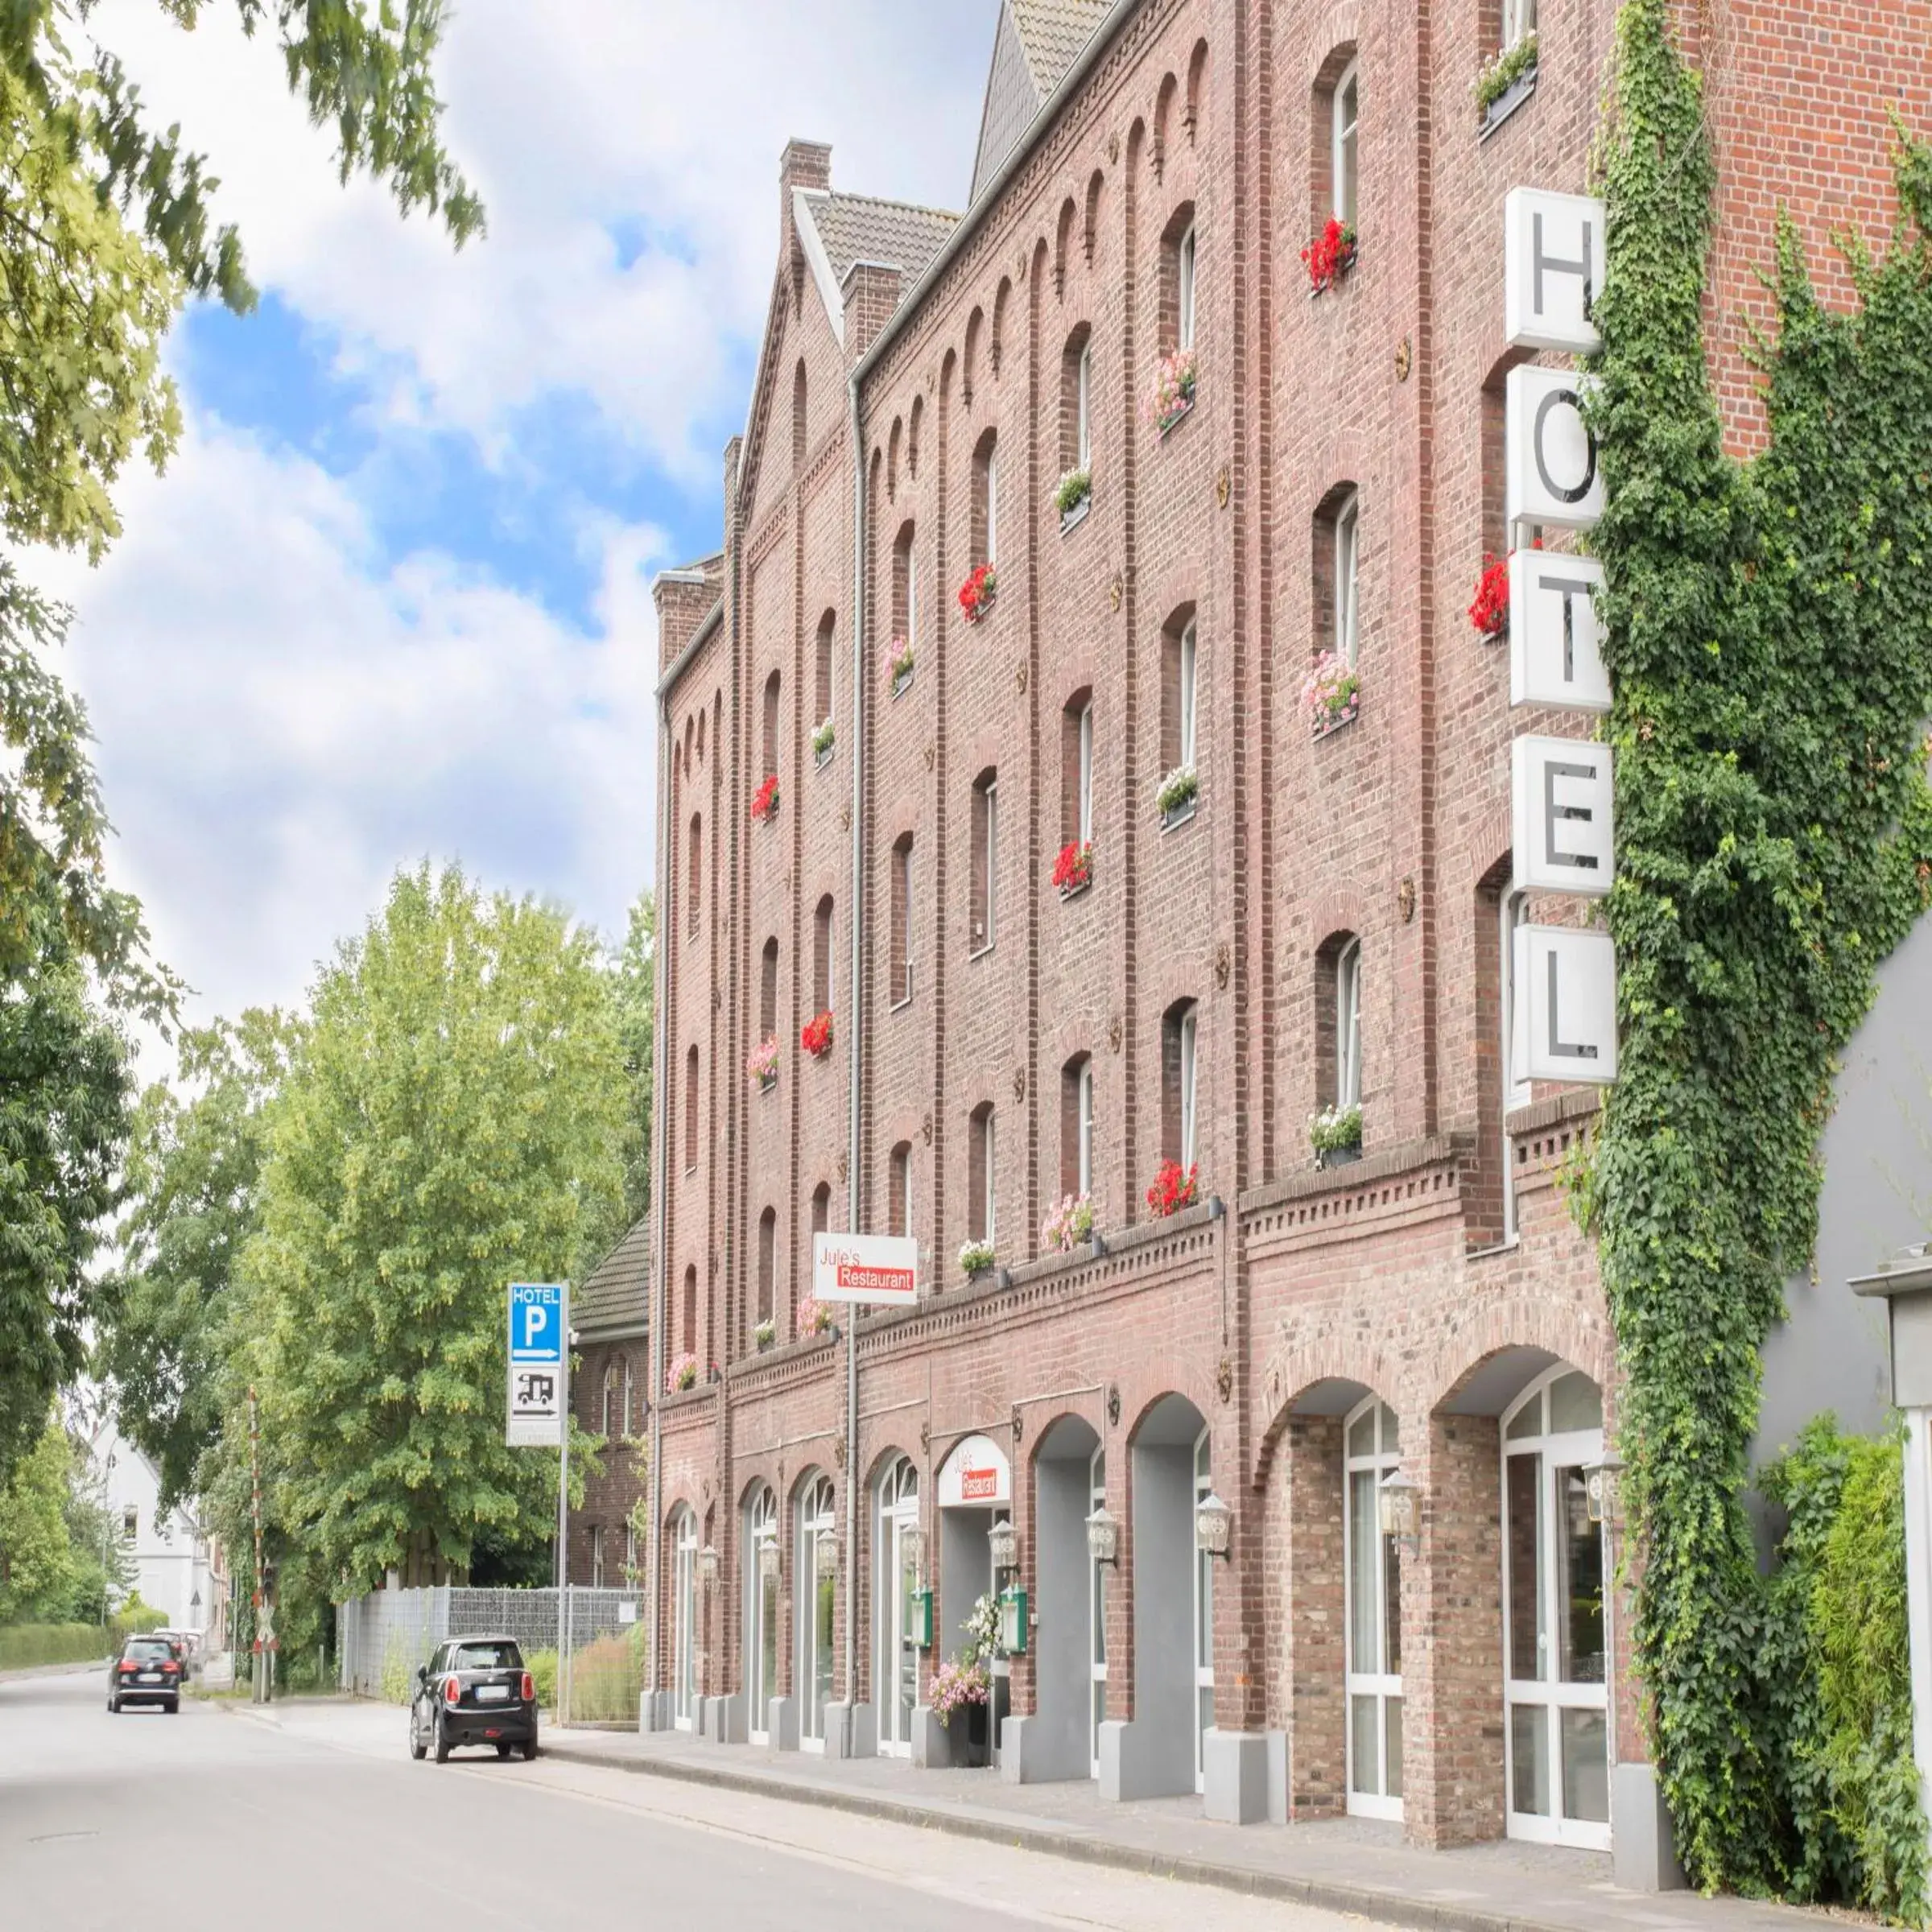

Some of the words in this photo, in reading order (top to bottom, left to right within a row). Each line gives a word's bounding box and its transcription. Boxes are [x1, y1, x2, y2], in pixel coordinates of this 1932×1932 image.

[1533, 213, 1599, 1059] HOTEL
[820, 1246, 861, 1267] Jule's
[840, 1267, 911, 1289] Restaurant
[513, 1288, 559, 1304] HOTEL
[525, 1305, 547, 1347] P
